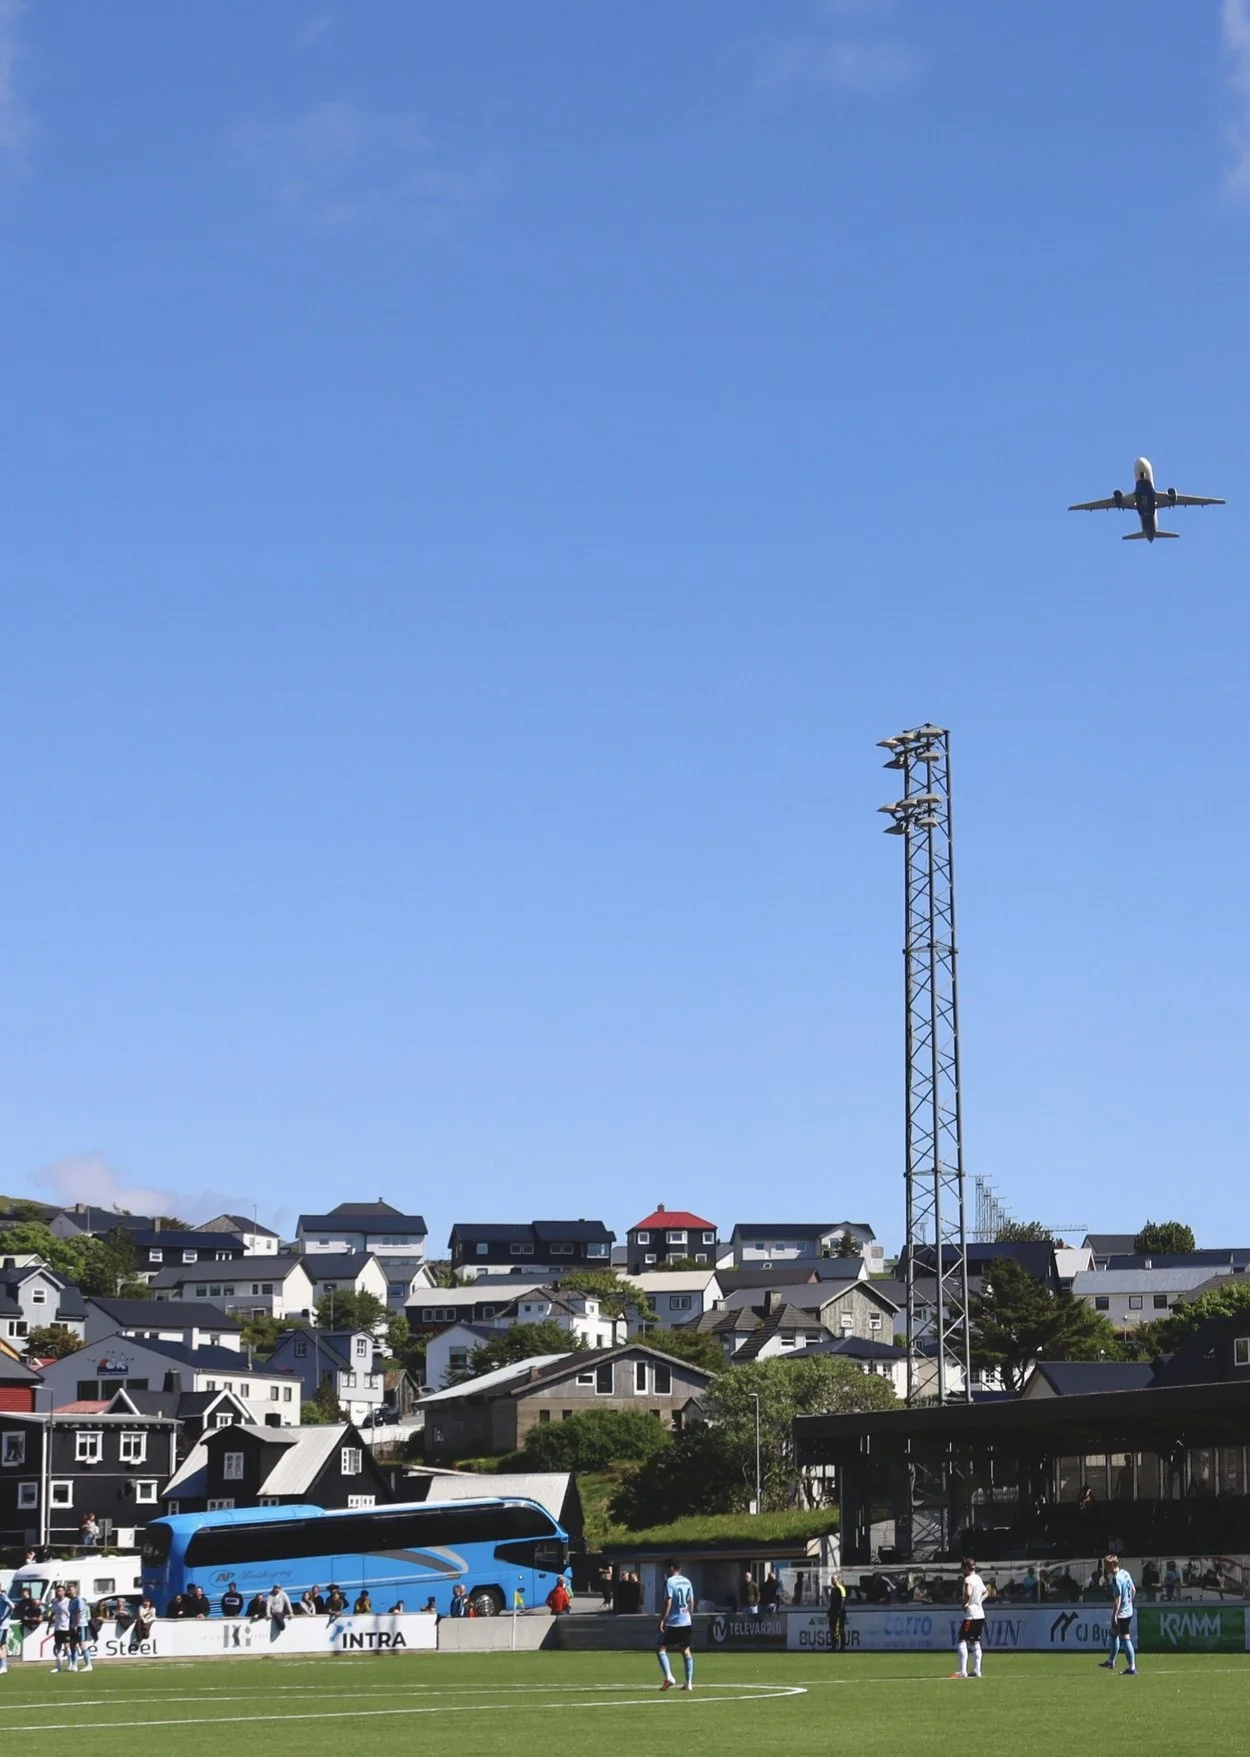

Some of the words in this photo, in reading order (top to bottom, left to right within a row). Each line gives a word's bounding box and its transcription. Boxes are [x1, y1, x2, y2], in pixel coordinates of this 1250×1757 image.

[799, 1630, 860, 1646] BUSEUR
[950, 1620, 1022, 1646] VNIN
[1160, 1612, 1221, 1646] KRAMM
[105, 1639, 158, 1656] Steel
[342, 1631, 407, 1649] INTRA
